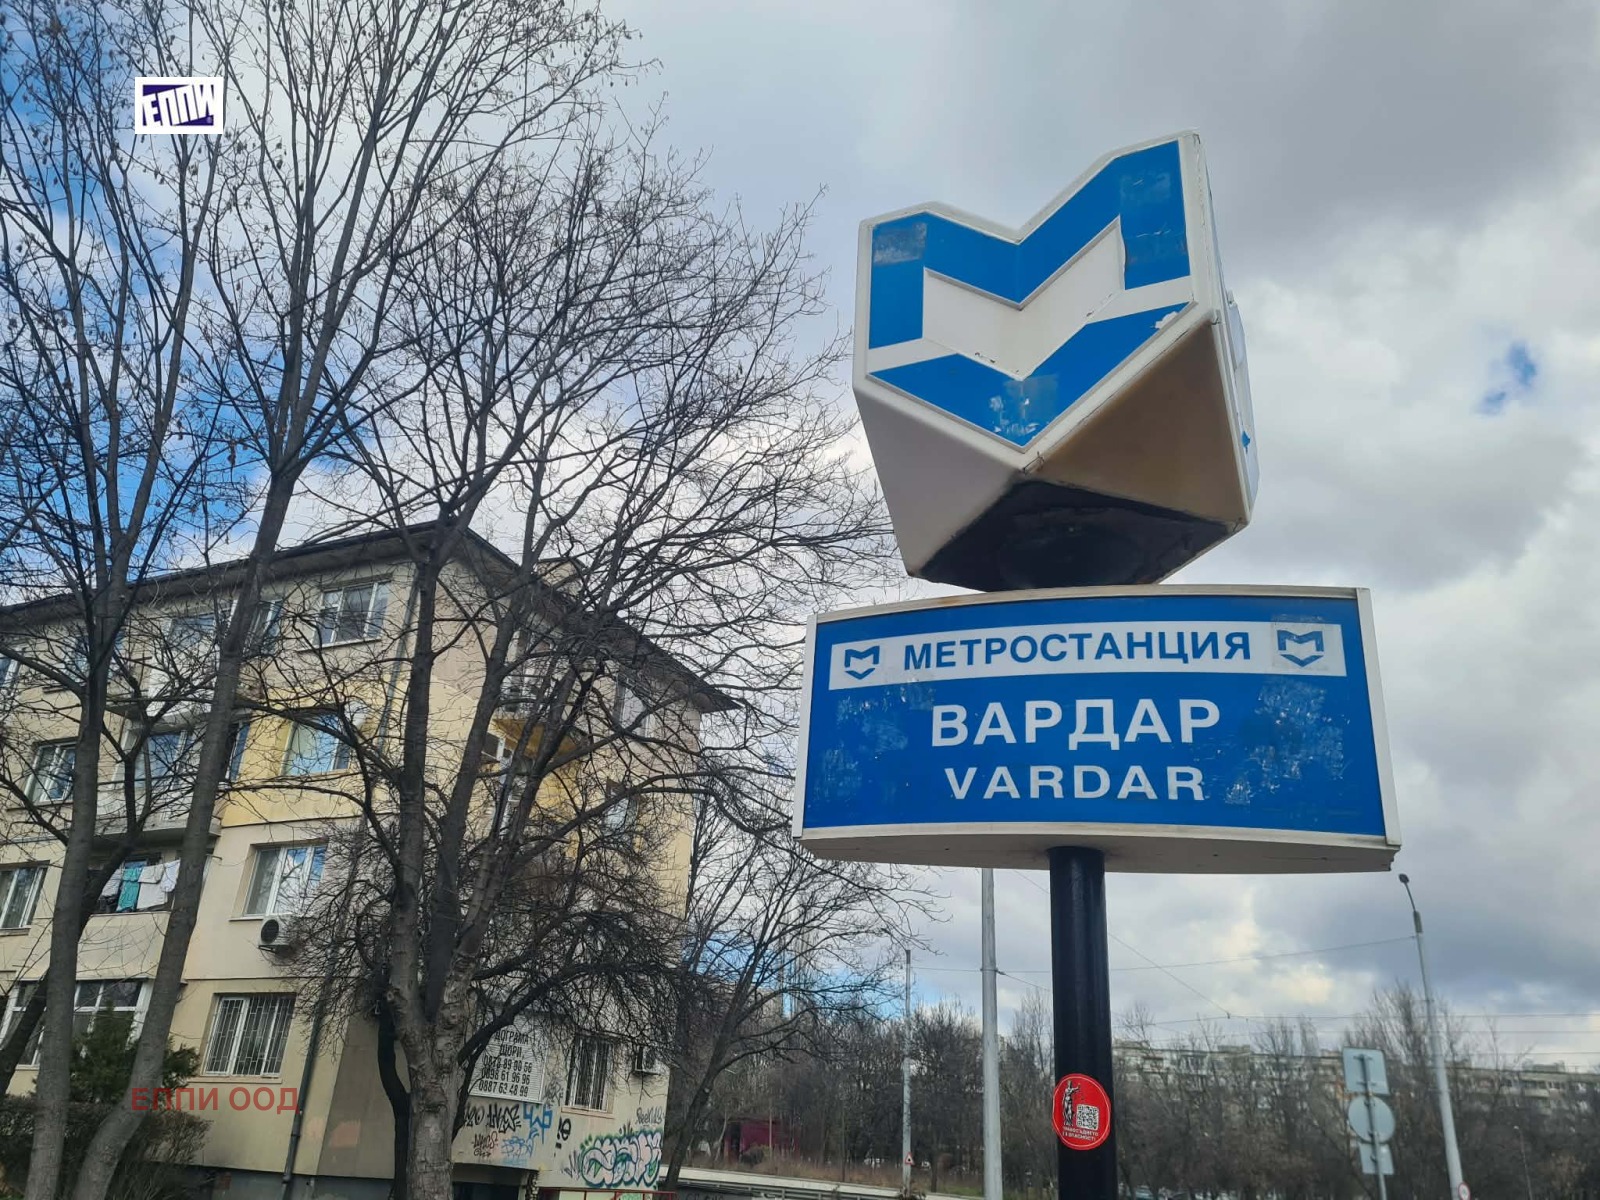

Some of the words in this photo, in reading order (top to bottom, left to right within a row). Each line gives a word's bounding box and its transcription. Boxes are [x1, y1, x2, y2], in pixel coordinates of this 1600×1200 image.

[903, 630, 1252, 670] МЕТРОСТАНЦИЯ
[931, 698, 1221, 751] ВАРДАР
[944, 765, 1205, 801] VARDAR
[478, 1080, 498, 1093] 0887
[501, 1070, 509, 1082] 61
